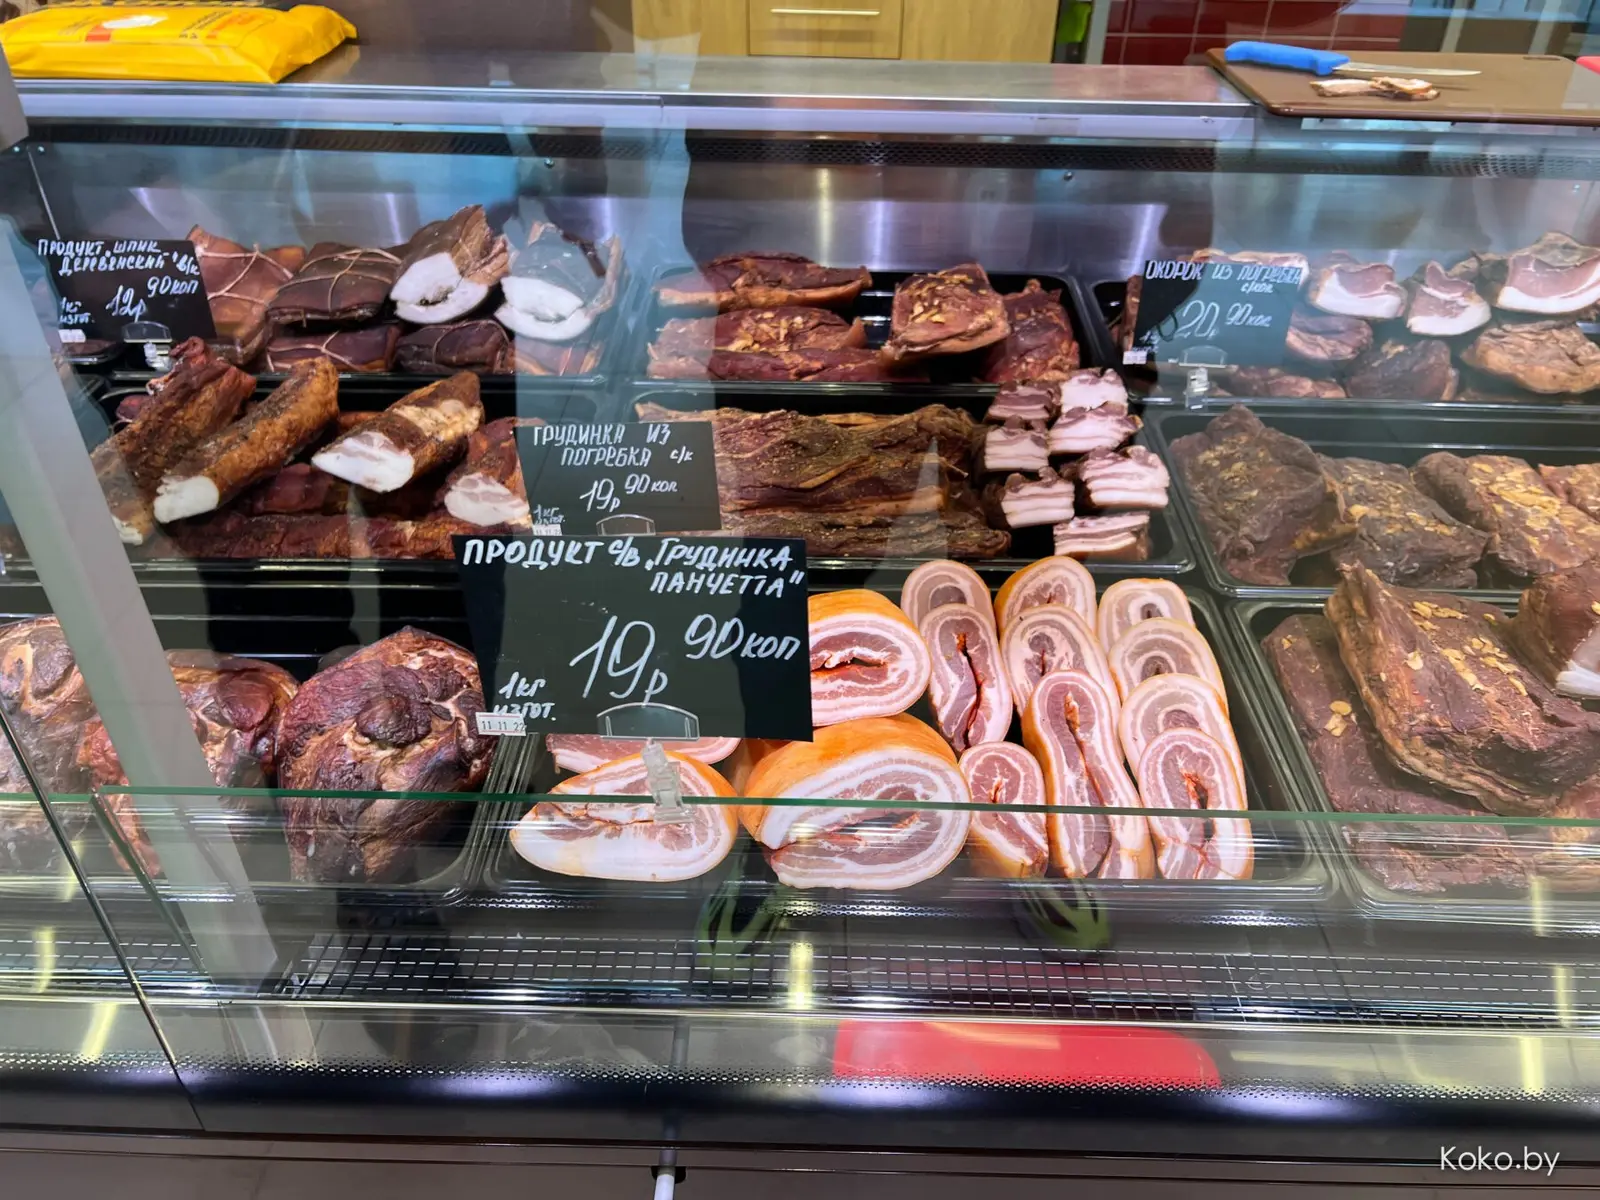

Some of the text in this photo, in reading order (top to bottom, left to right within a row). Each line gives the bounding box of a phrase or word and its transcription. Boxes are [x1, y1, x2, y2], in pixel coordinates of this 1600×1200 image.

[38, 239, 104, 258] ПРОДУКТ
[1145, 260, 1202, 281] ОКОРОК
[1212, 265, 1233, 281] ИЗ
[533, 423, 672, 447] ГРУДИНКА ИЗ
[561, 445, 694, 467] ПОГРЕБКА с/к
[462, 538, 605, 570] ПРОДУКТ
[607, 537, 641, 568] с/в
[499, 671, 546, 699] 1кг
